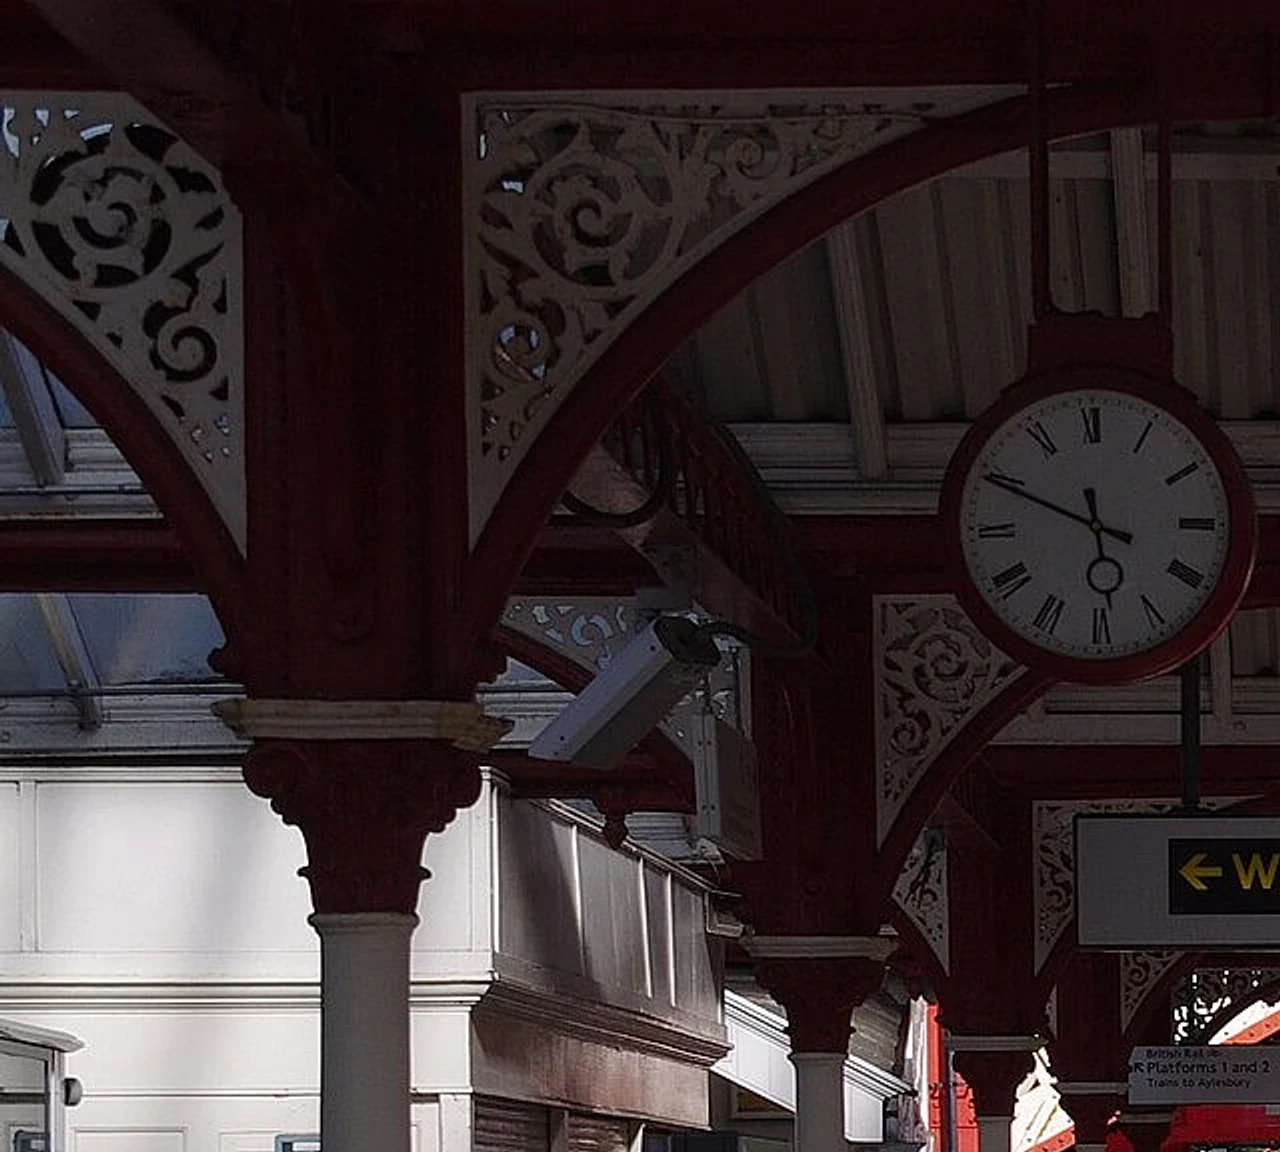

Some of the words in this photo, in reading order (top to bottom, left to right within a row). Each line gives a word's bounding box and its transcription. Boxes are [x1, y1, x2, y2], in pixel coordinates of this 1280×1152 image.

[1147, 1061, 1217, 1073] Platforms
[1222, 1062, 1228, 1073] 1
[1231, 1061, 1258, 1073] and
[1262, 1061, 1271, 1073] 2
[1147, 1078, 1179, 1088] Trains
[1182, 1078, 1195, 1088] to
[1197, 1078, 1251, 1089] Aylesbury
